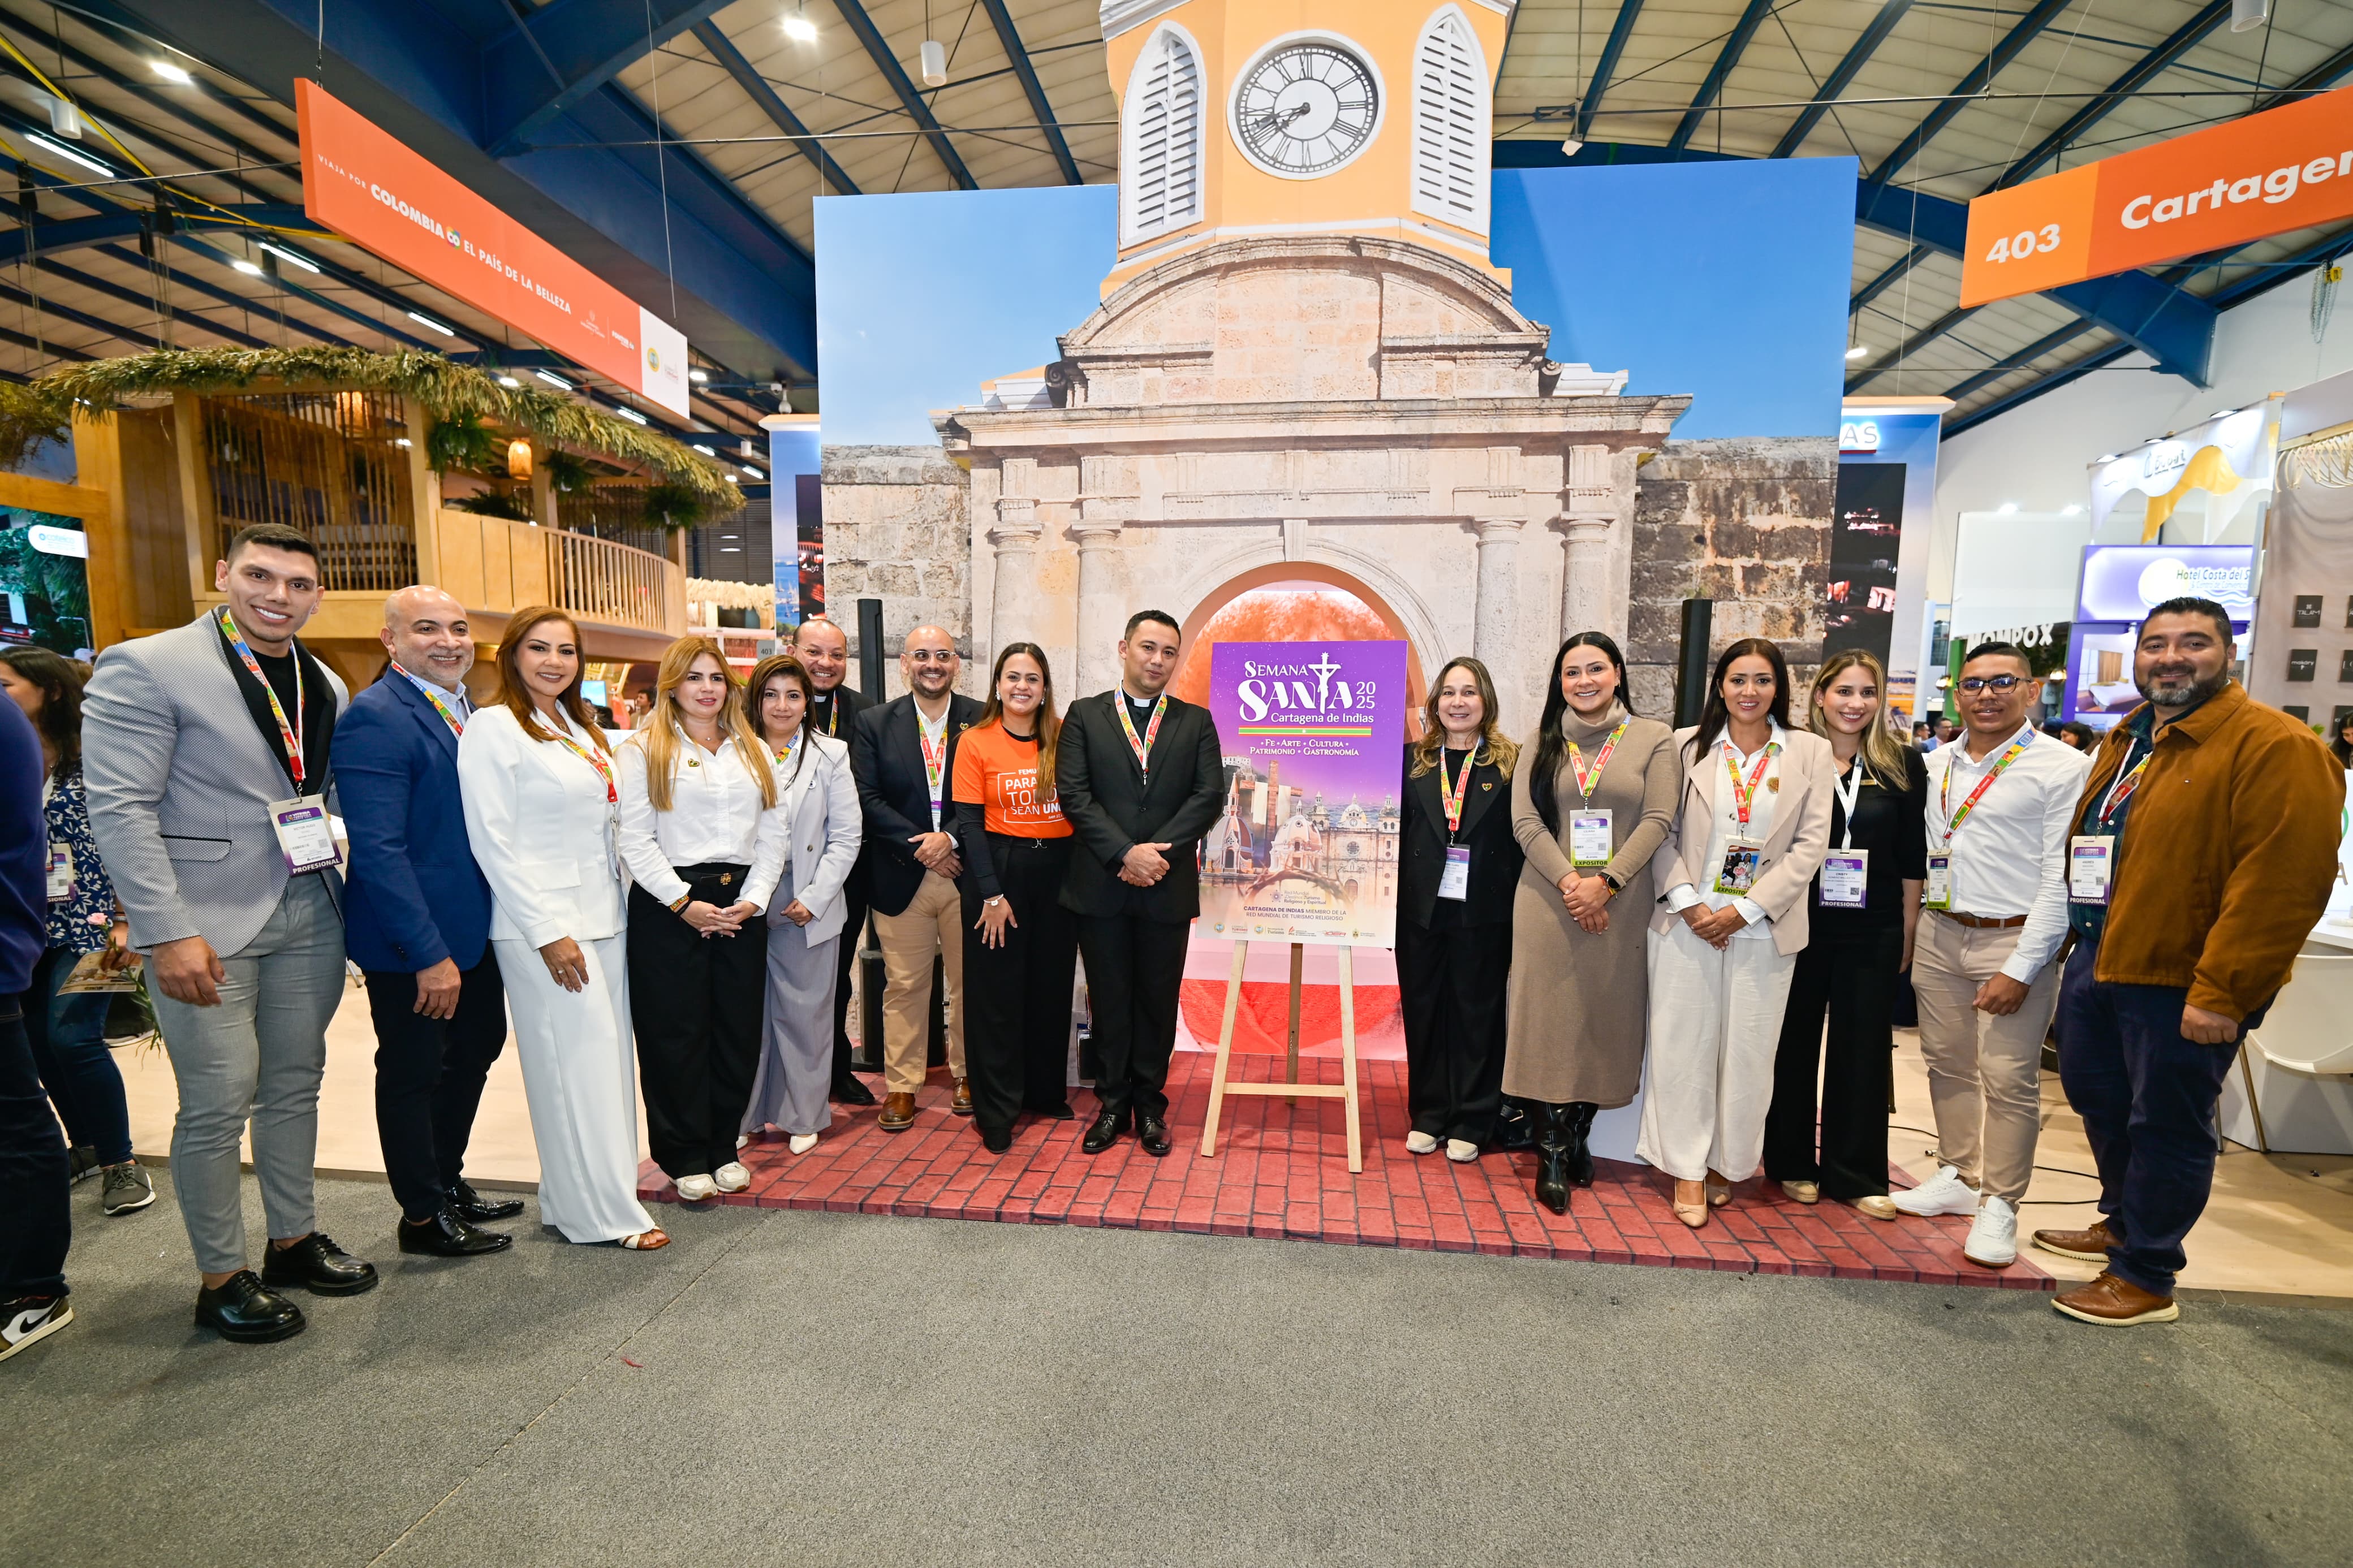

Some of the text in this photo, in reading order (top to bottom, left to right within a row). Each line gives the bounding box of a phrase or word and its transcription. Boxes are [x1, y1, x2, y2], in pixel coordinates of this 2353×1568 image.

[318, 154, 345, 176] VIAJA
[349, 173, 367, 189] POR
[370, 184, 445, 239] COLOMBIA
[464, 240, 476, 257] EL
[479, 249, 502, 272] PAÍS
[505, 265, 518, 282] DE
[521, 275, 533, 291] LA
[536, 284, 572, 315] BELLEZA
[1985, 223, 2061, 264] 403
[2177, 569, 2200, 580] Hotel
[2203, 569, 2227, 580] Costa
[2229, 569, 2243, 580] del
[1244, 660, 1309, 677] SEMANA
[1238, 663, 1376, 722] SANTA 20
[1356, 696, 1376, 709] 25
[1271, 712, 1374, 724] Cartagena de Indias
[1309, 739, 1344, 748] CULTURA
[1303, 748, 1359, 756] GASTRONOMÍA
[1005, 777, 1037, 791] PARA
[1011, 805, 1040, 815] SEAN
[292, 858, 340, 874] PROFESIONAL
